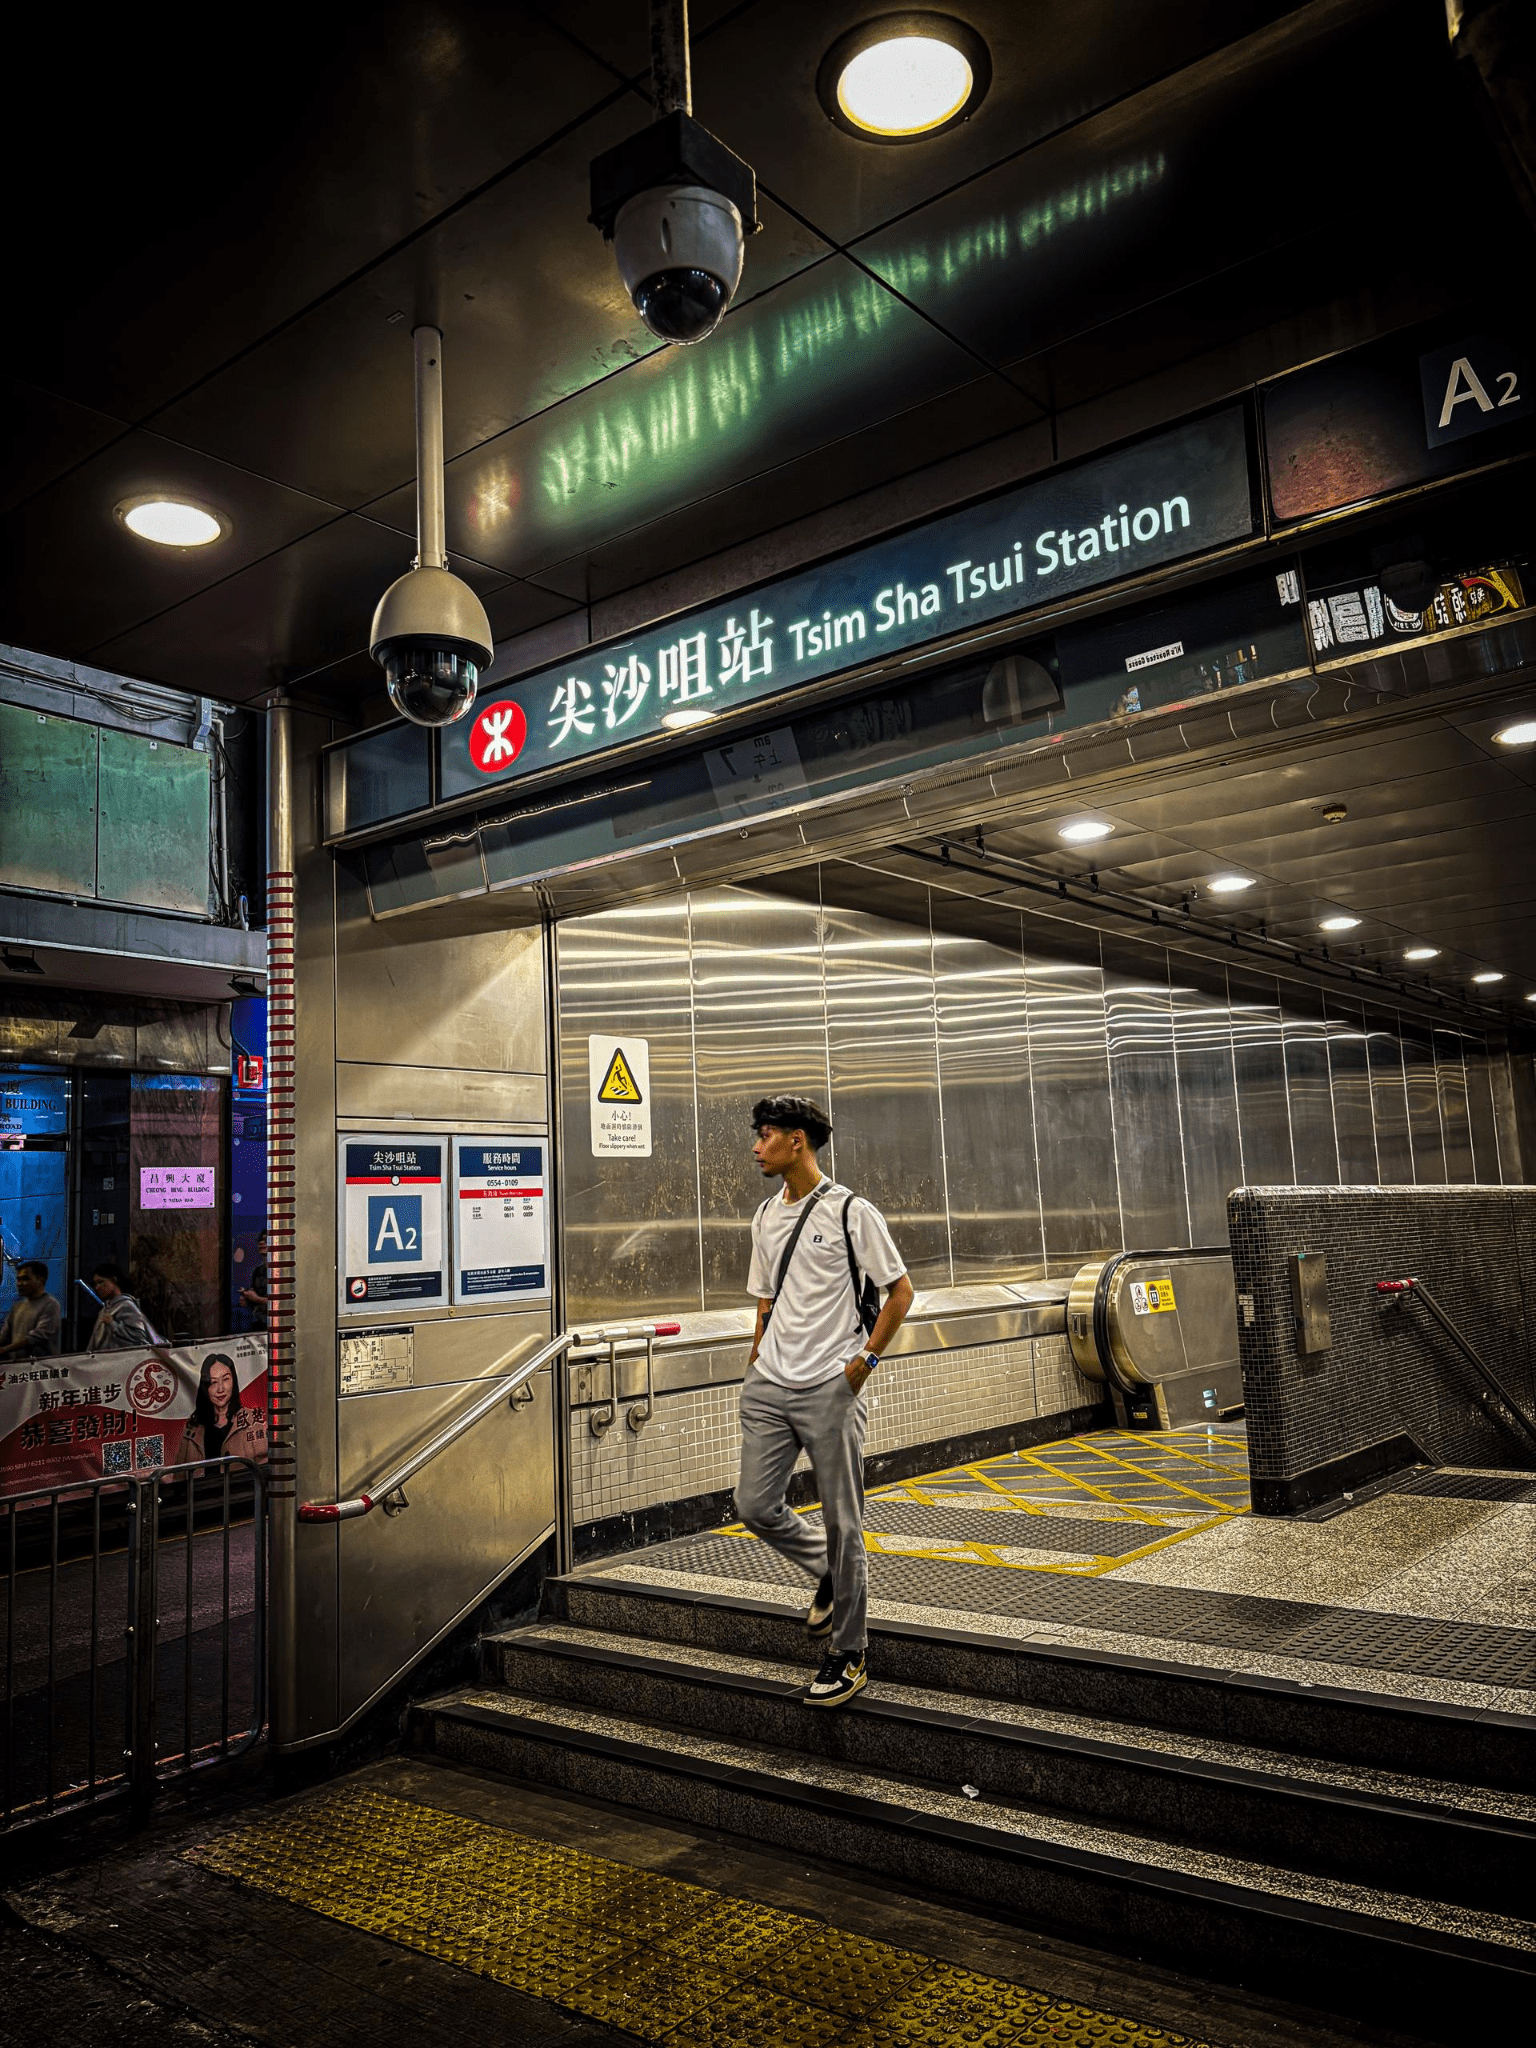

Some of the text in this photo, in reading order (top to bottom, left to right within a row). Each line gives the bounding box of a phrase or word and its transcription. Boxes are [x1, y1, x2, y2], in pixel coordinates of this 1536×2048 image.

[1438, 357, 1520, 427] A2
[547, 609, 774, 748] 尖沙咀站
[788, 610, 866, 661] Tsim
[875, 581, 941, 633] Sha
[946, 541, 1024, 604] Tsui
[1035, 496, 1191, 575] Station
[5, 1098, 57, 1110] BUILDING
[612, 1110, 631, 1121] 小心!
[622, 1134, 636, 1142] care!
[373, 1151, 417, 1164] 尖沙咀站
[482, 1152, 520, 1164] 服務時間
[487, 1179, 518, 1187] 0554-0109
[375, 1207, 418, 1251] A2
[8, 1367, 70, 1384] 油尖旺區議會
[39, 1383, 122, 1411] 新年進步
[20, 1408, 138, 1450] 恭喜發財!
